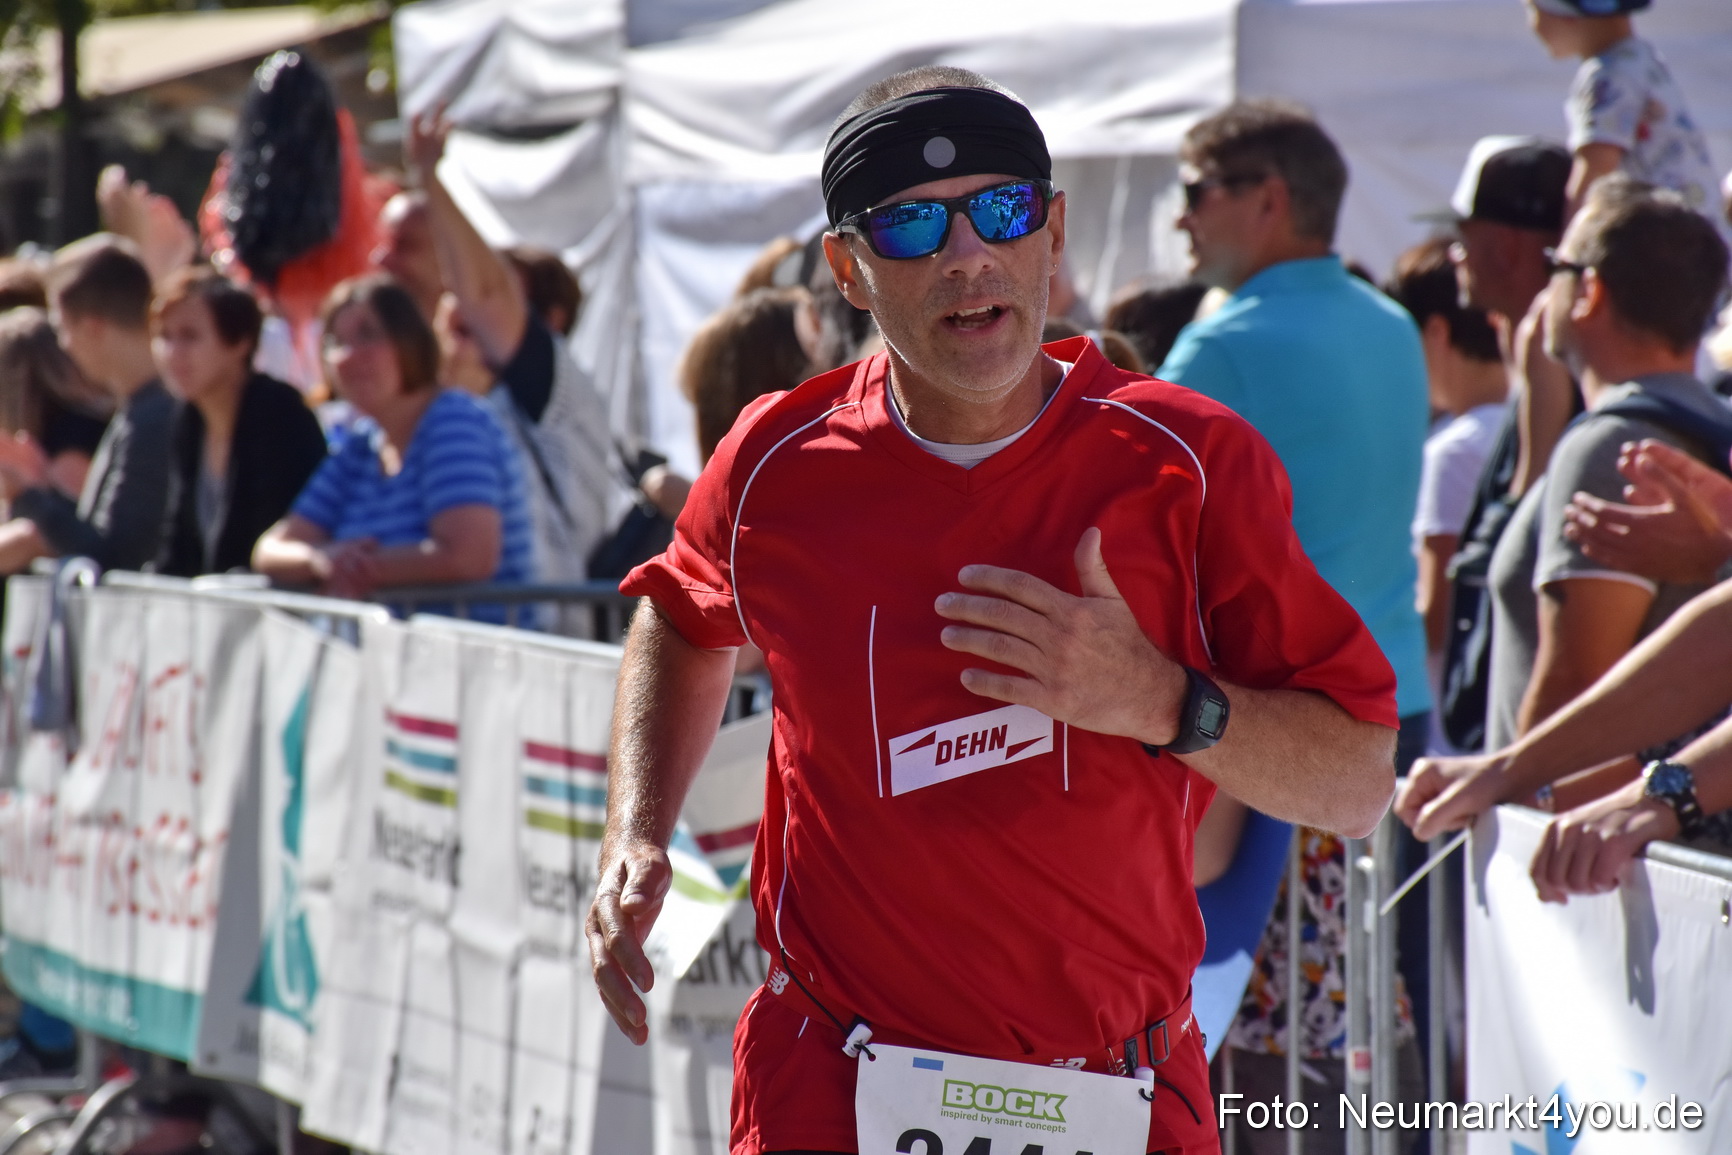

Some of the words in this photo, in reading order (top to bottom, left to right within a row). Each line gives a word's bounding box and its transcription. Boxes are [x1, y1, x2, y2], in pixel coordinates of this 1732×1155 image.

[935, 724, 1008, 766] DEHN
[939, 1107, 979, 1122] inspired
[981, 1113, 992, 1125] by
[994, 1117, 1023, 1128] smart
[1025, 1121, 1067, 1134] concepts
[942, 1079, 1068, 1123] BOCK
